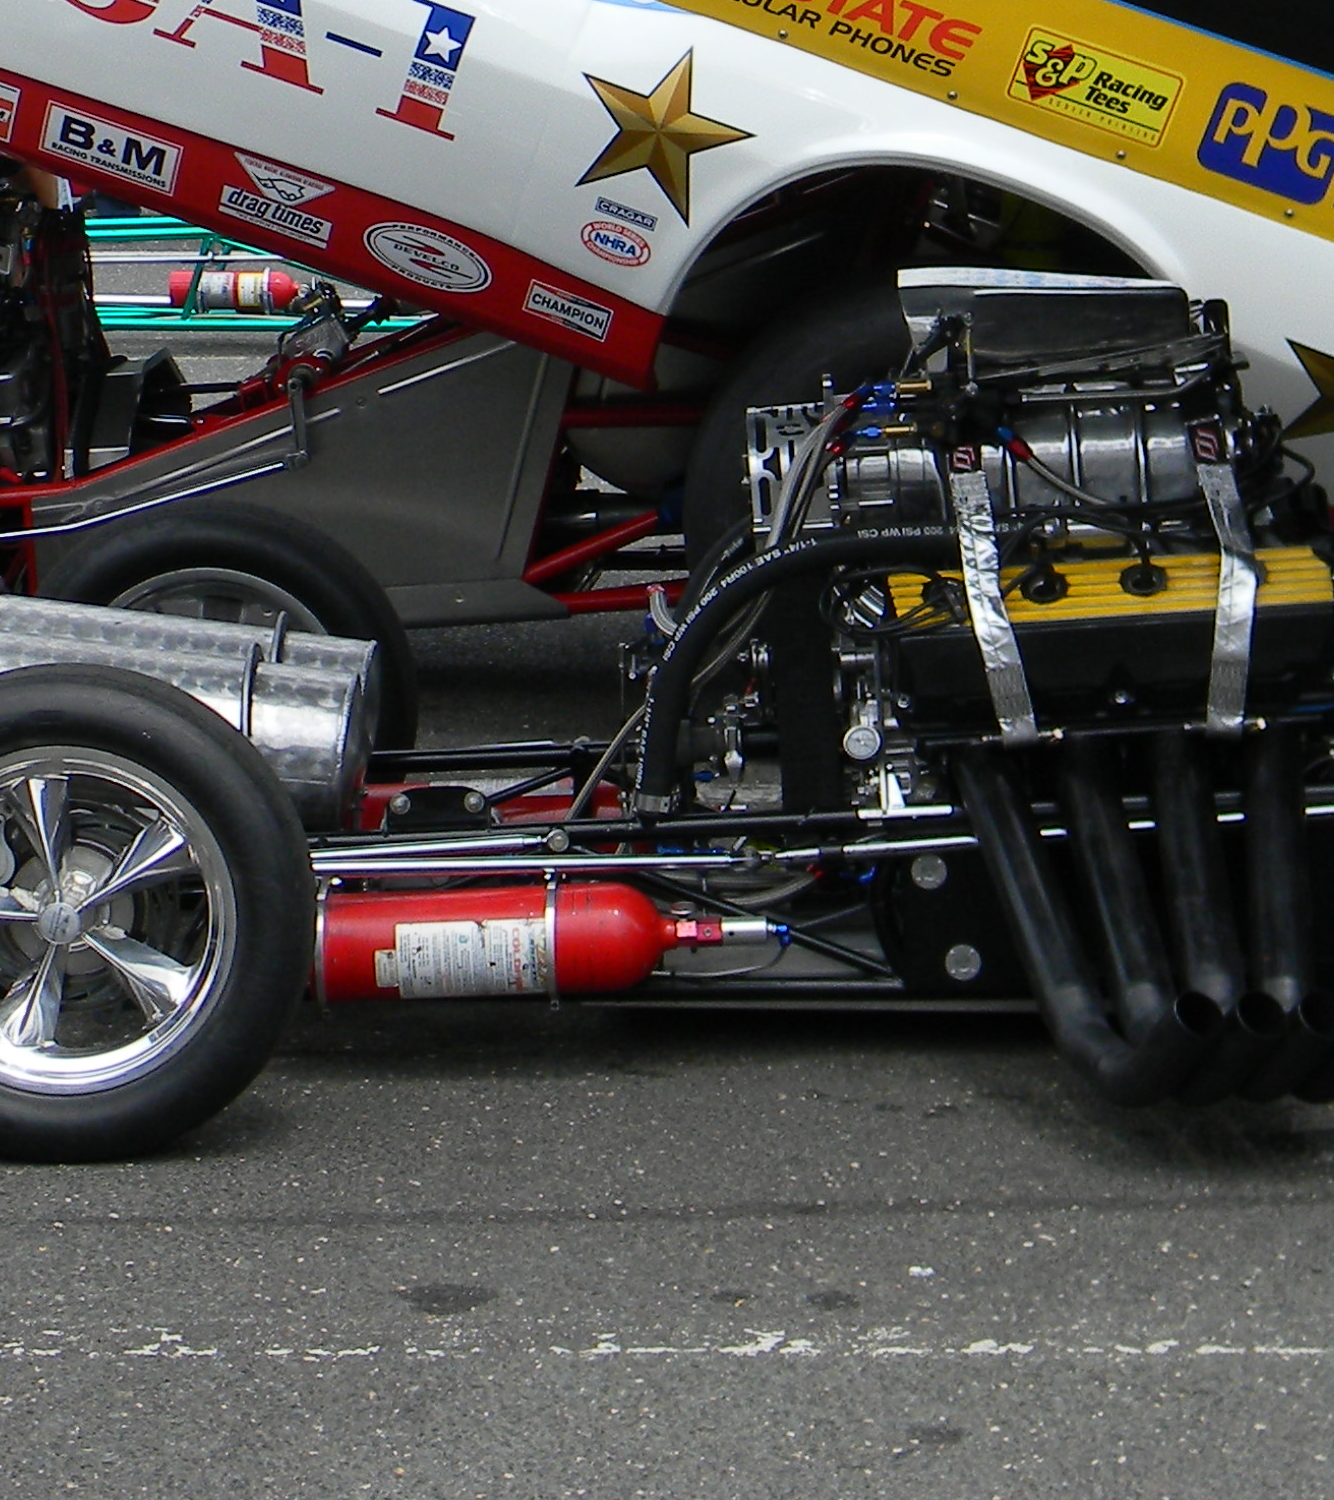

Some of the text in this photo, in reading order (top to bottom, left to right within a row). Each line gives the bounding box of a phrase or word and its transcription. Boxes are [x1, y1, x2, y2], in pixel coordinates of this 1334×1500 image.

[828, 20, 956, 77] PHONES
[1023, 40, 1098, 87] S&P
[1084, 86, 1132, 114] Tees
[1092, 70, 1169, 112] Racing
[52, 141, 167, 188] RACING TRANSMISSIONS
[227, 188, 271, 218] drag
[270, 203, 324, 235] times
[600, 201, 654, 227] CRAGAR
[393, 243, 460, 272] DEVELCO
[594, 231, 636, 257] NHRA
[391, 264, 453, 290] PRODUCTS
[531, 292, 605, 331] CHAMPION
[755, 548, 781, 567] SAE
[720, 562, 754, 588] 100R4
[700, 587, 718, 607] 200
